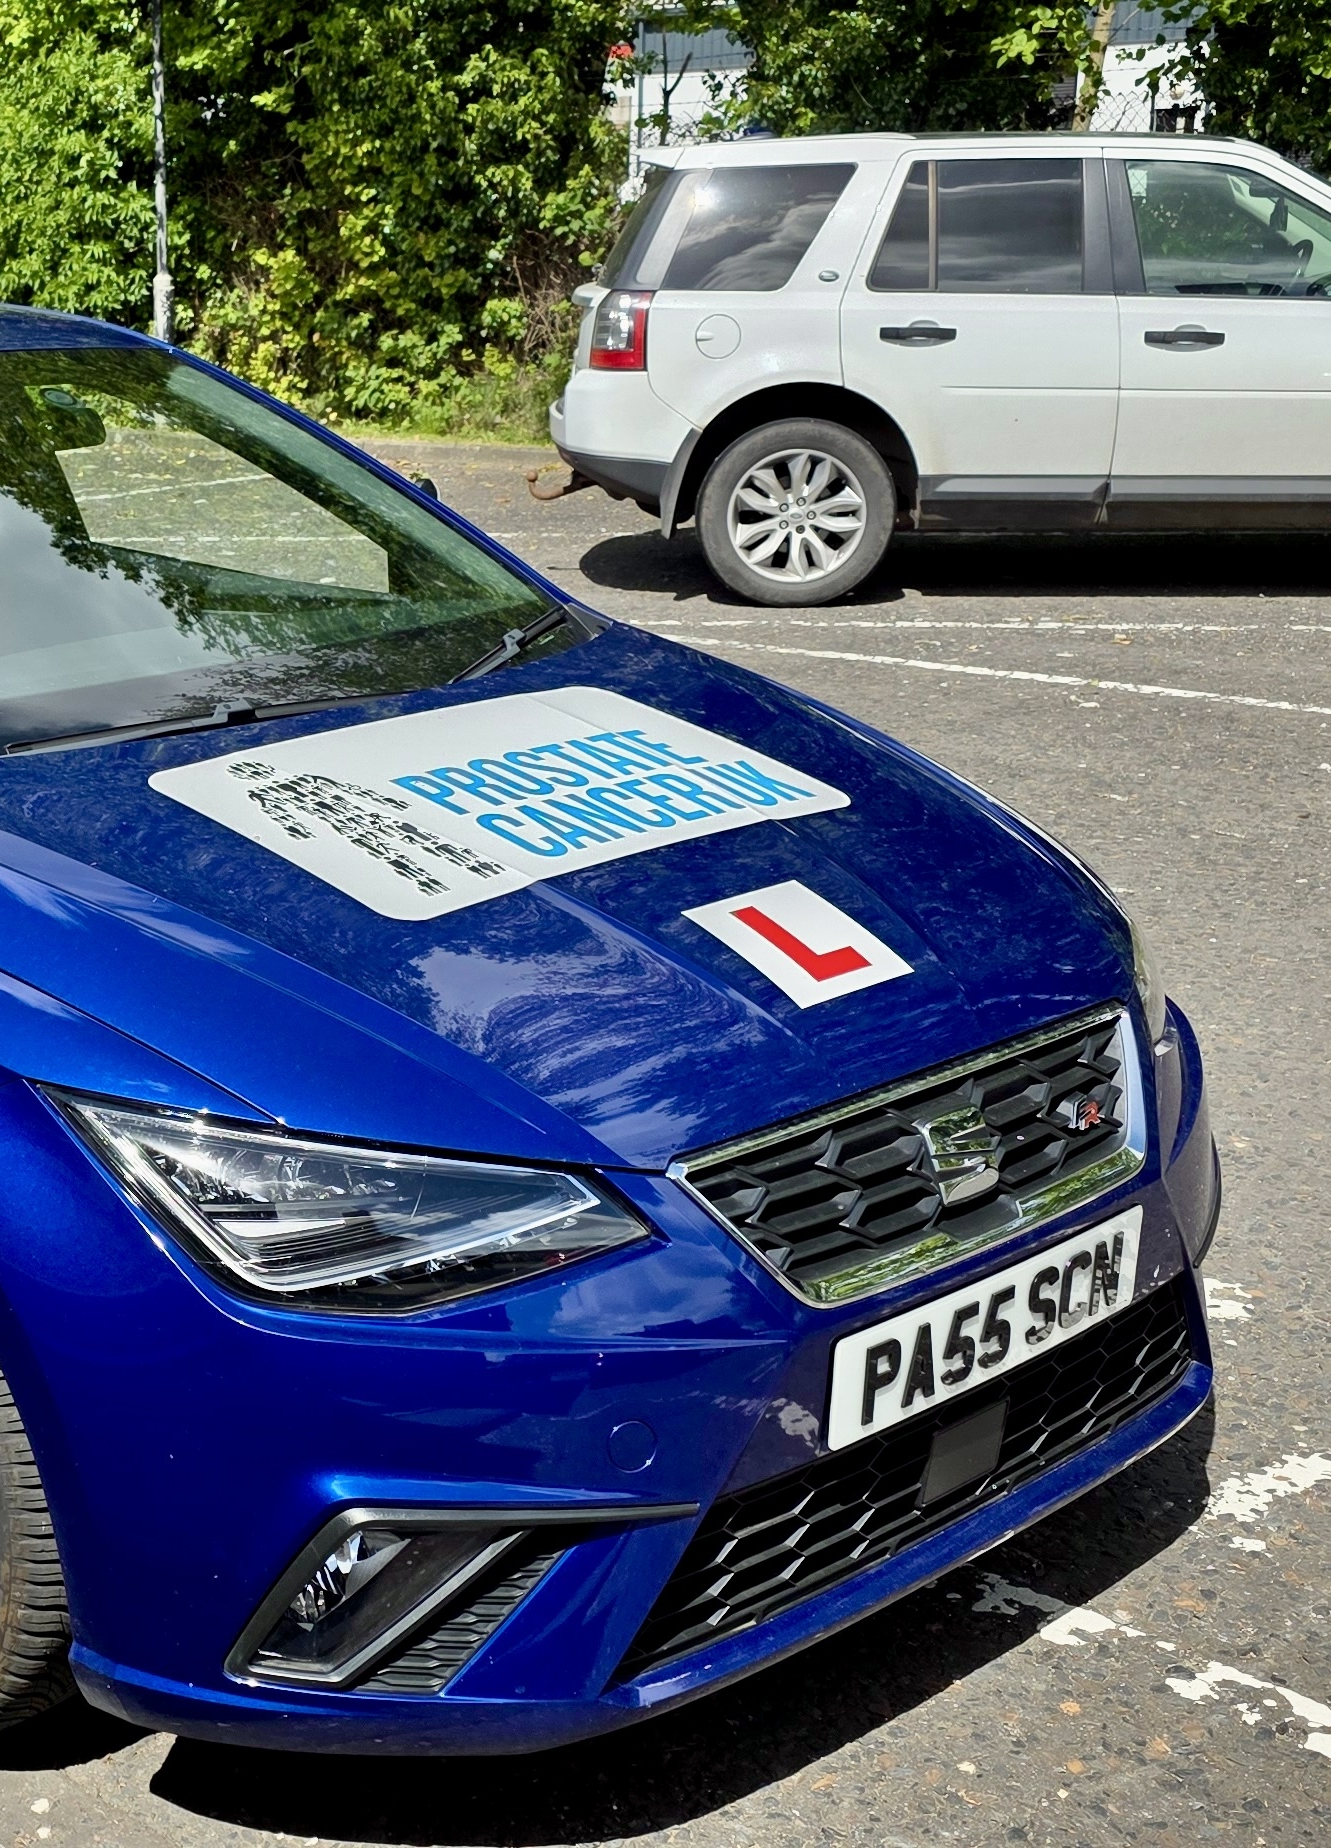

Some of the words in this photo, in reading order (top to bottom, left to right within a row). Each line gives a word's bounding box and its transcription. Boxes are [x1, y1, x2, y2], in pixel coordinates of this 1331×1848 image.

[389, 730, 710, 815] PROSTATE
[728, 906, 874, 982] L
[1024, 1231, 1125, 1346] SCN
